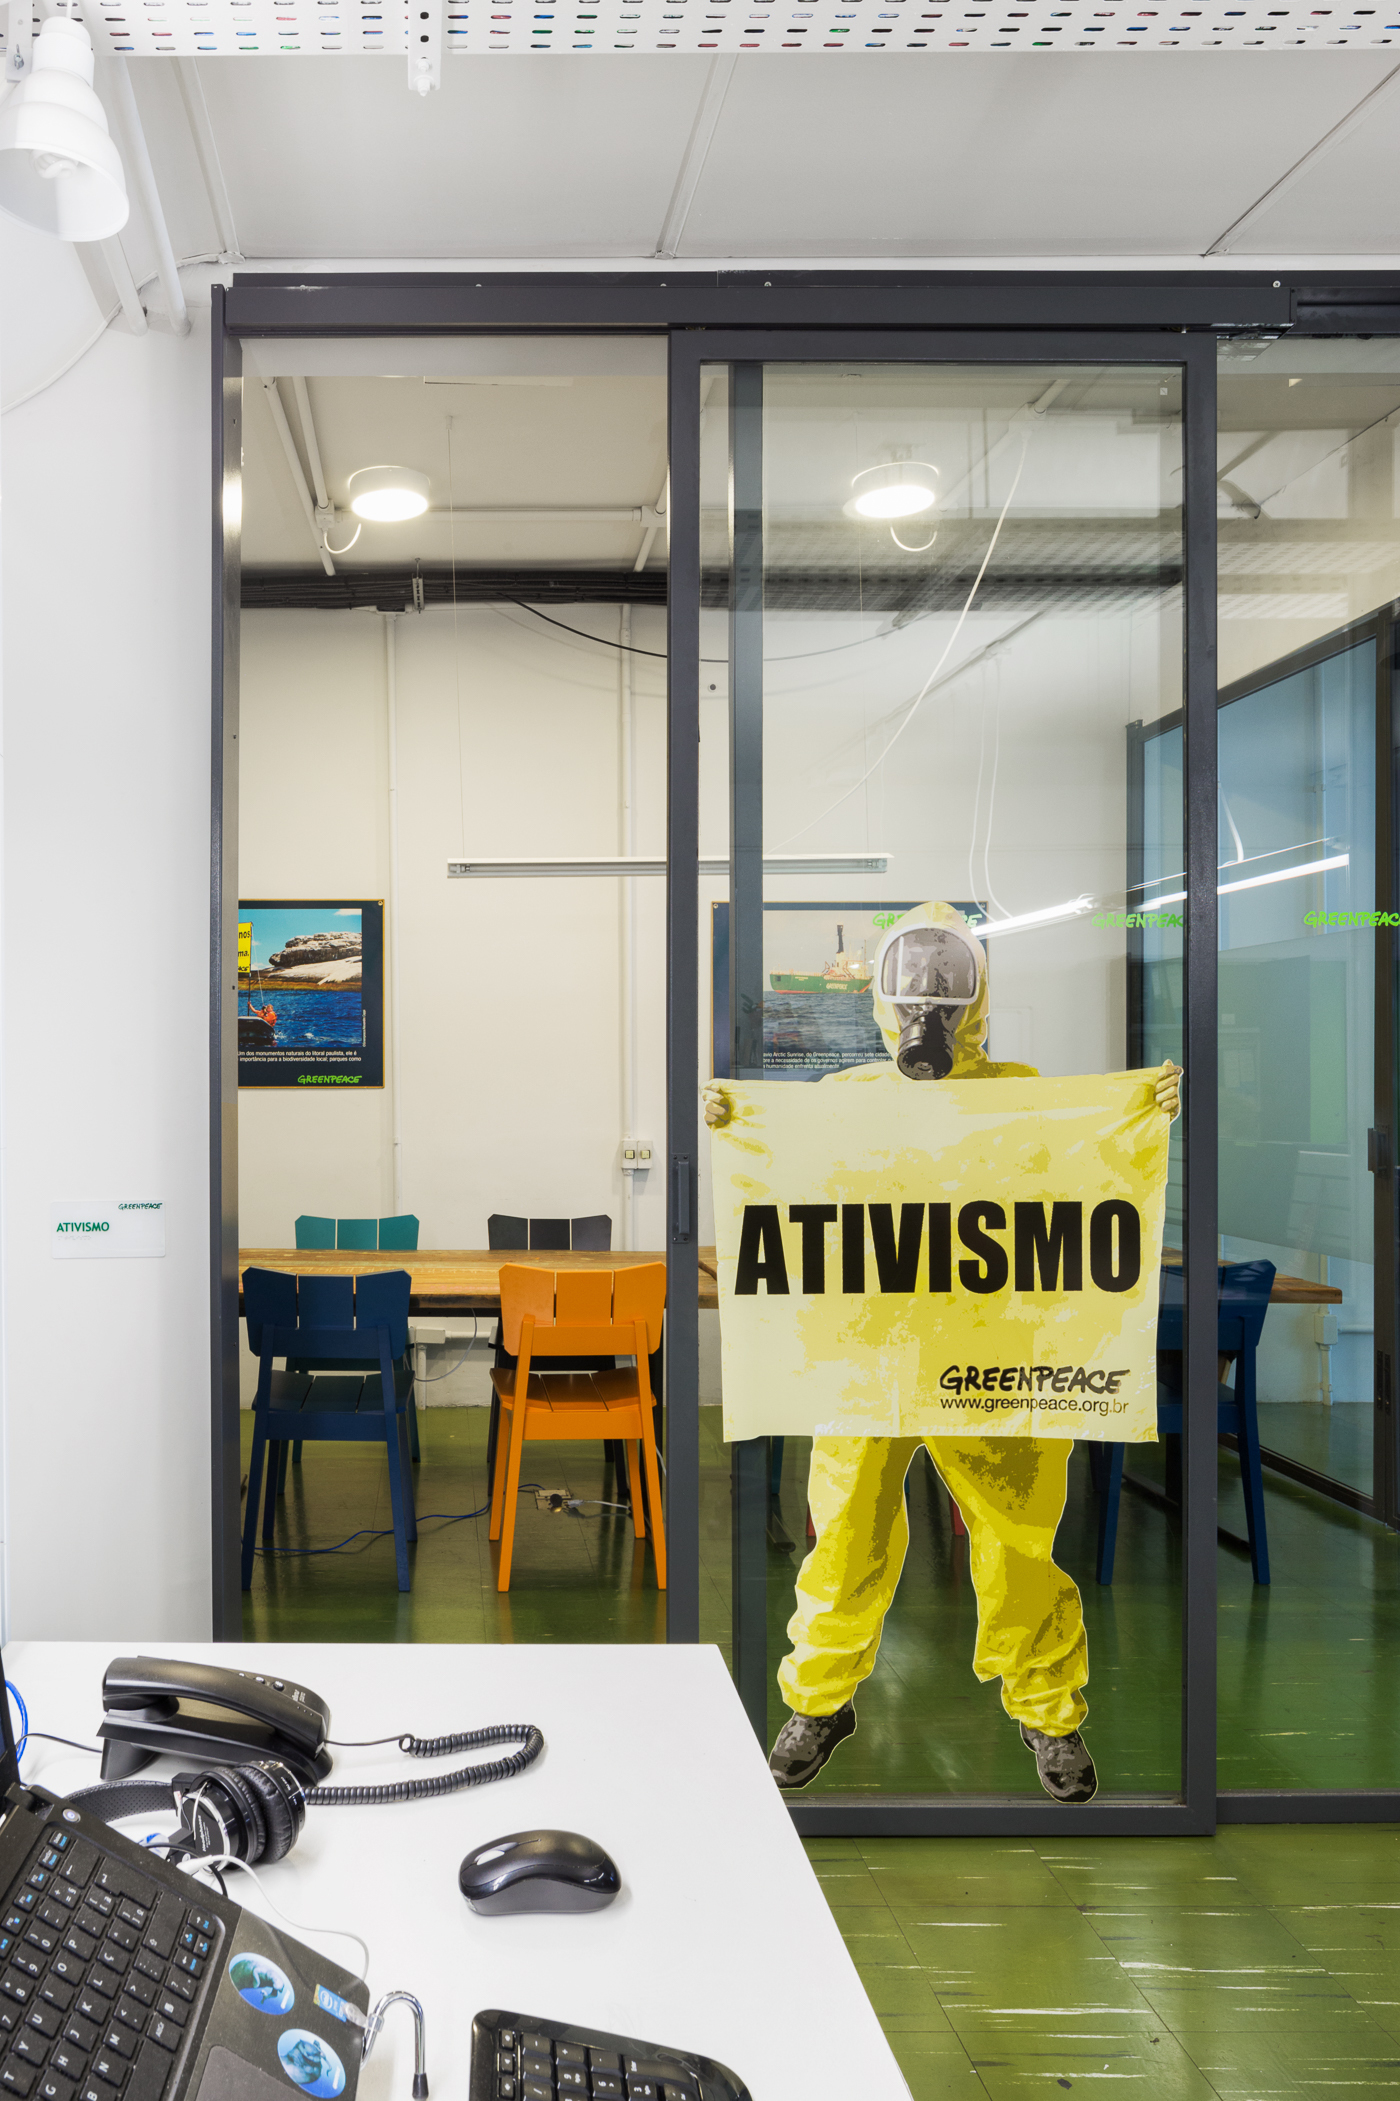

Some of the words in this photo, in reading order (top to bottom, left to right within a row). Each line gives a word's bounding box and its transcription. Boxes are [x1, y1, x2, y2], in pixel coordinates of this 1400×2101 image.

[1304, 910, 1400, 928] GREENPEAC
[298, 1074, 362, 1084] GREENPEACE
[118, 1202, 162, 1210] GREENPEACE
[56, 1222, 110, 1232] ATIVISMO
[734, 1199, 1142, 1295] ATIVISMO
[939, 1365, 1131, 1396] GREENPEACE
[940, 1398, 1130, 1416] www.greenpeace.org.br
[68, 1939, 77, 1949] P
[93, 1978, 103, 1987] L
[16, 1987, 26, 1997] 8
[82, 2001, 92, 2012] K
[2, 2014, 11, 2024] 7
[32, 2013, 42, 2024] U
[70, 2029, 80, 2039] J
[109, 2033, 120, 2045] M
[18, 2040, 29, 2051] Y
[57, 2055, 69, 2067] H
[98, 2061, 109, 2073] N
[4, 2070, 14, 2081] T
[86, 2090, 98, 2101] B
